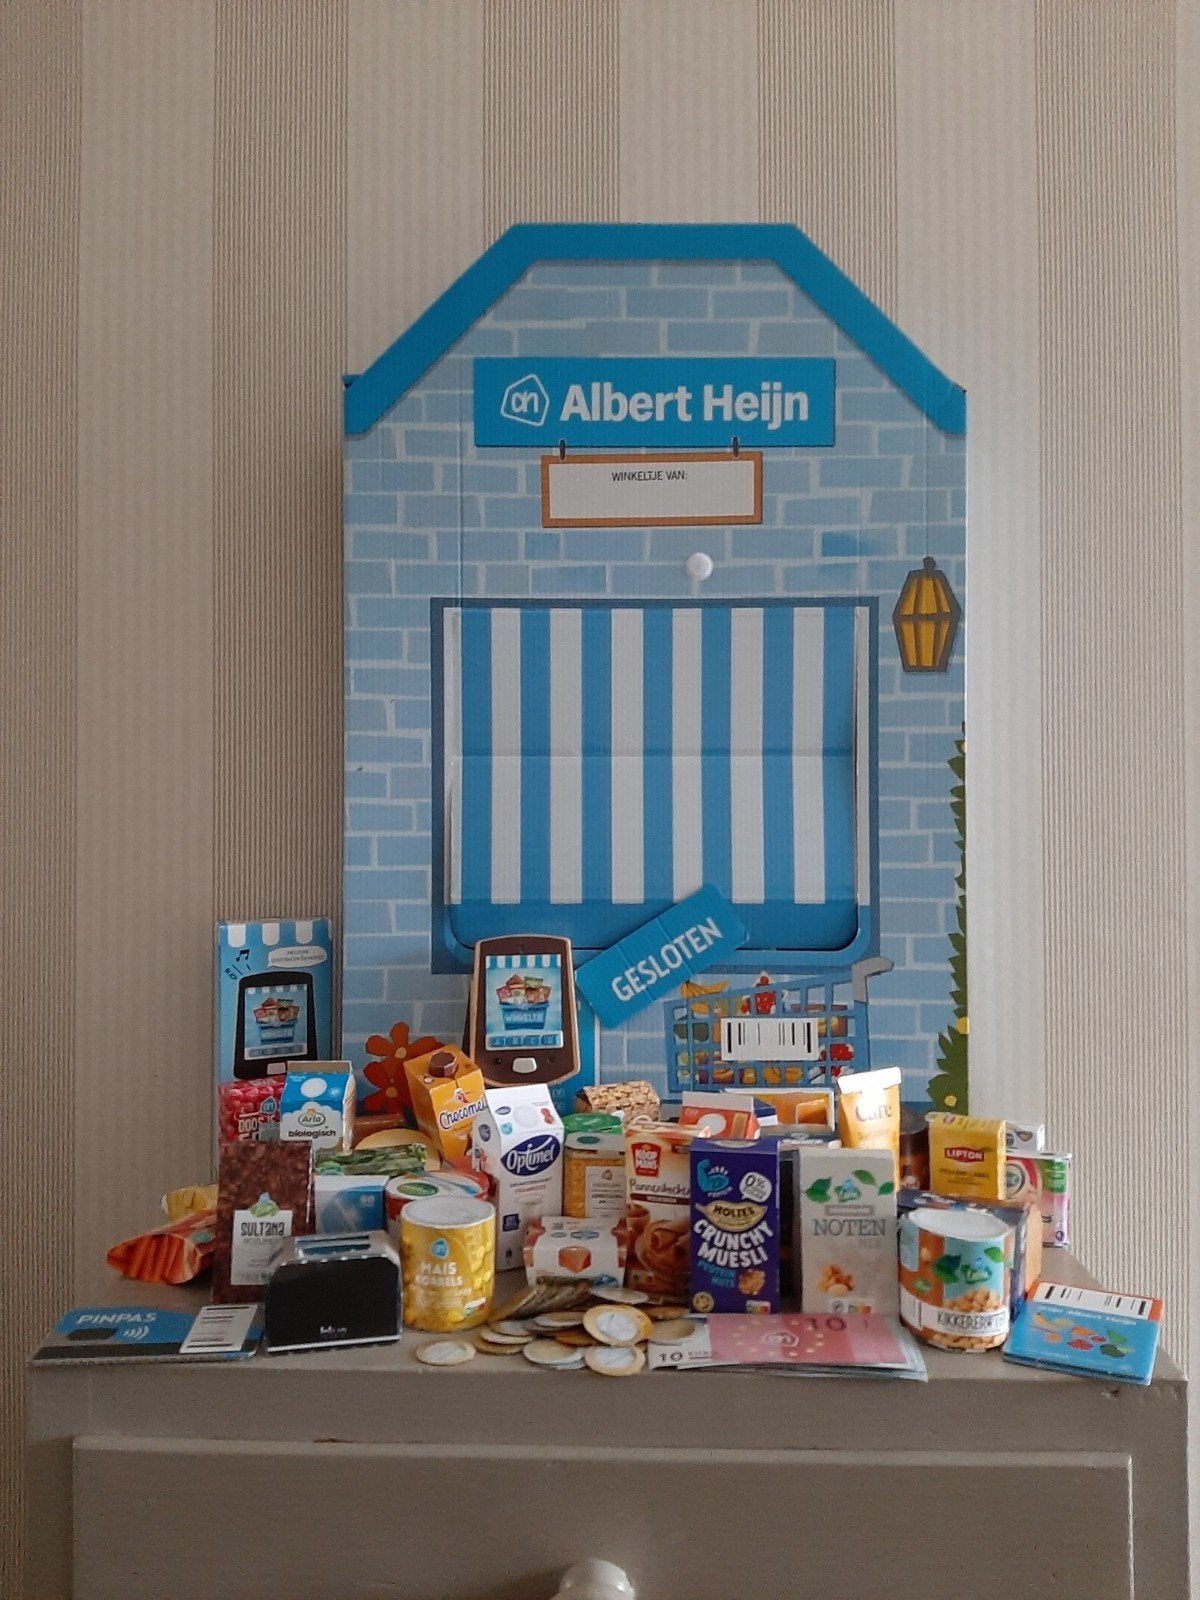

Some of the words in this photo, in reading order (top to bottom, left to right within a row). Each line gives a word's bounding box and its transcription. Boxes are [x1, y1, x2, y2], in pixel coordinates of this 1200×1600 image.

[560, 381, 692, 423] Albert
[703, 381, 809, 431] Heijn
[612, 471, 663, 482] WINKELTJE
[667, 470, 688, 481] VAN:
[611, 917, 724, 1001] GESLOTEN
[301, 1113, 322, 1124] Arla
[855, 1103, 893, 1123] Care
[288, 1126, 337, 1140] biologisch
[505, 1137, 556, 1174] Optimel
[945, 1147, 984, 1160] LIPTON
[693, 1218, 775, 1252] CRUNCHY
[811, 1218, 887, 1237] NOTEN
[696, 1241, 769, 1269] MUESLI
[76, 1312, 157, 1325] PINPAS
[810, 1316, 848, 1332] 10
[659, 1351, 683, 1362] 10
